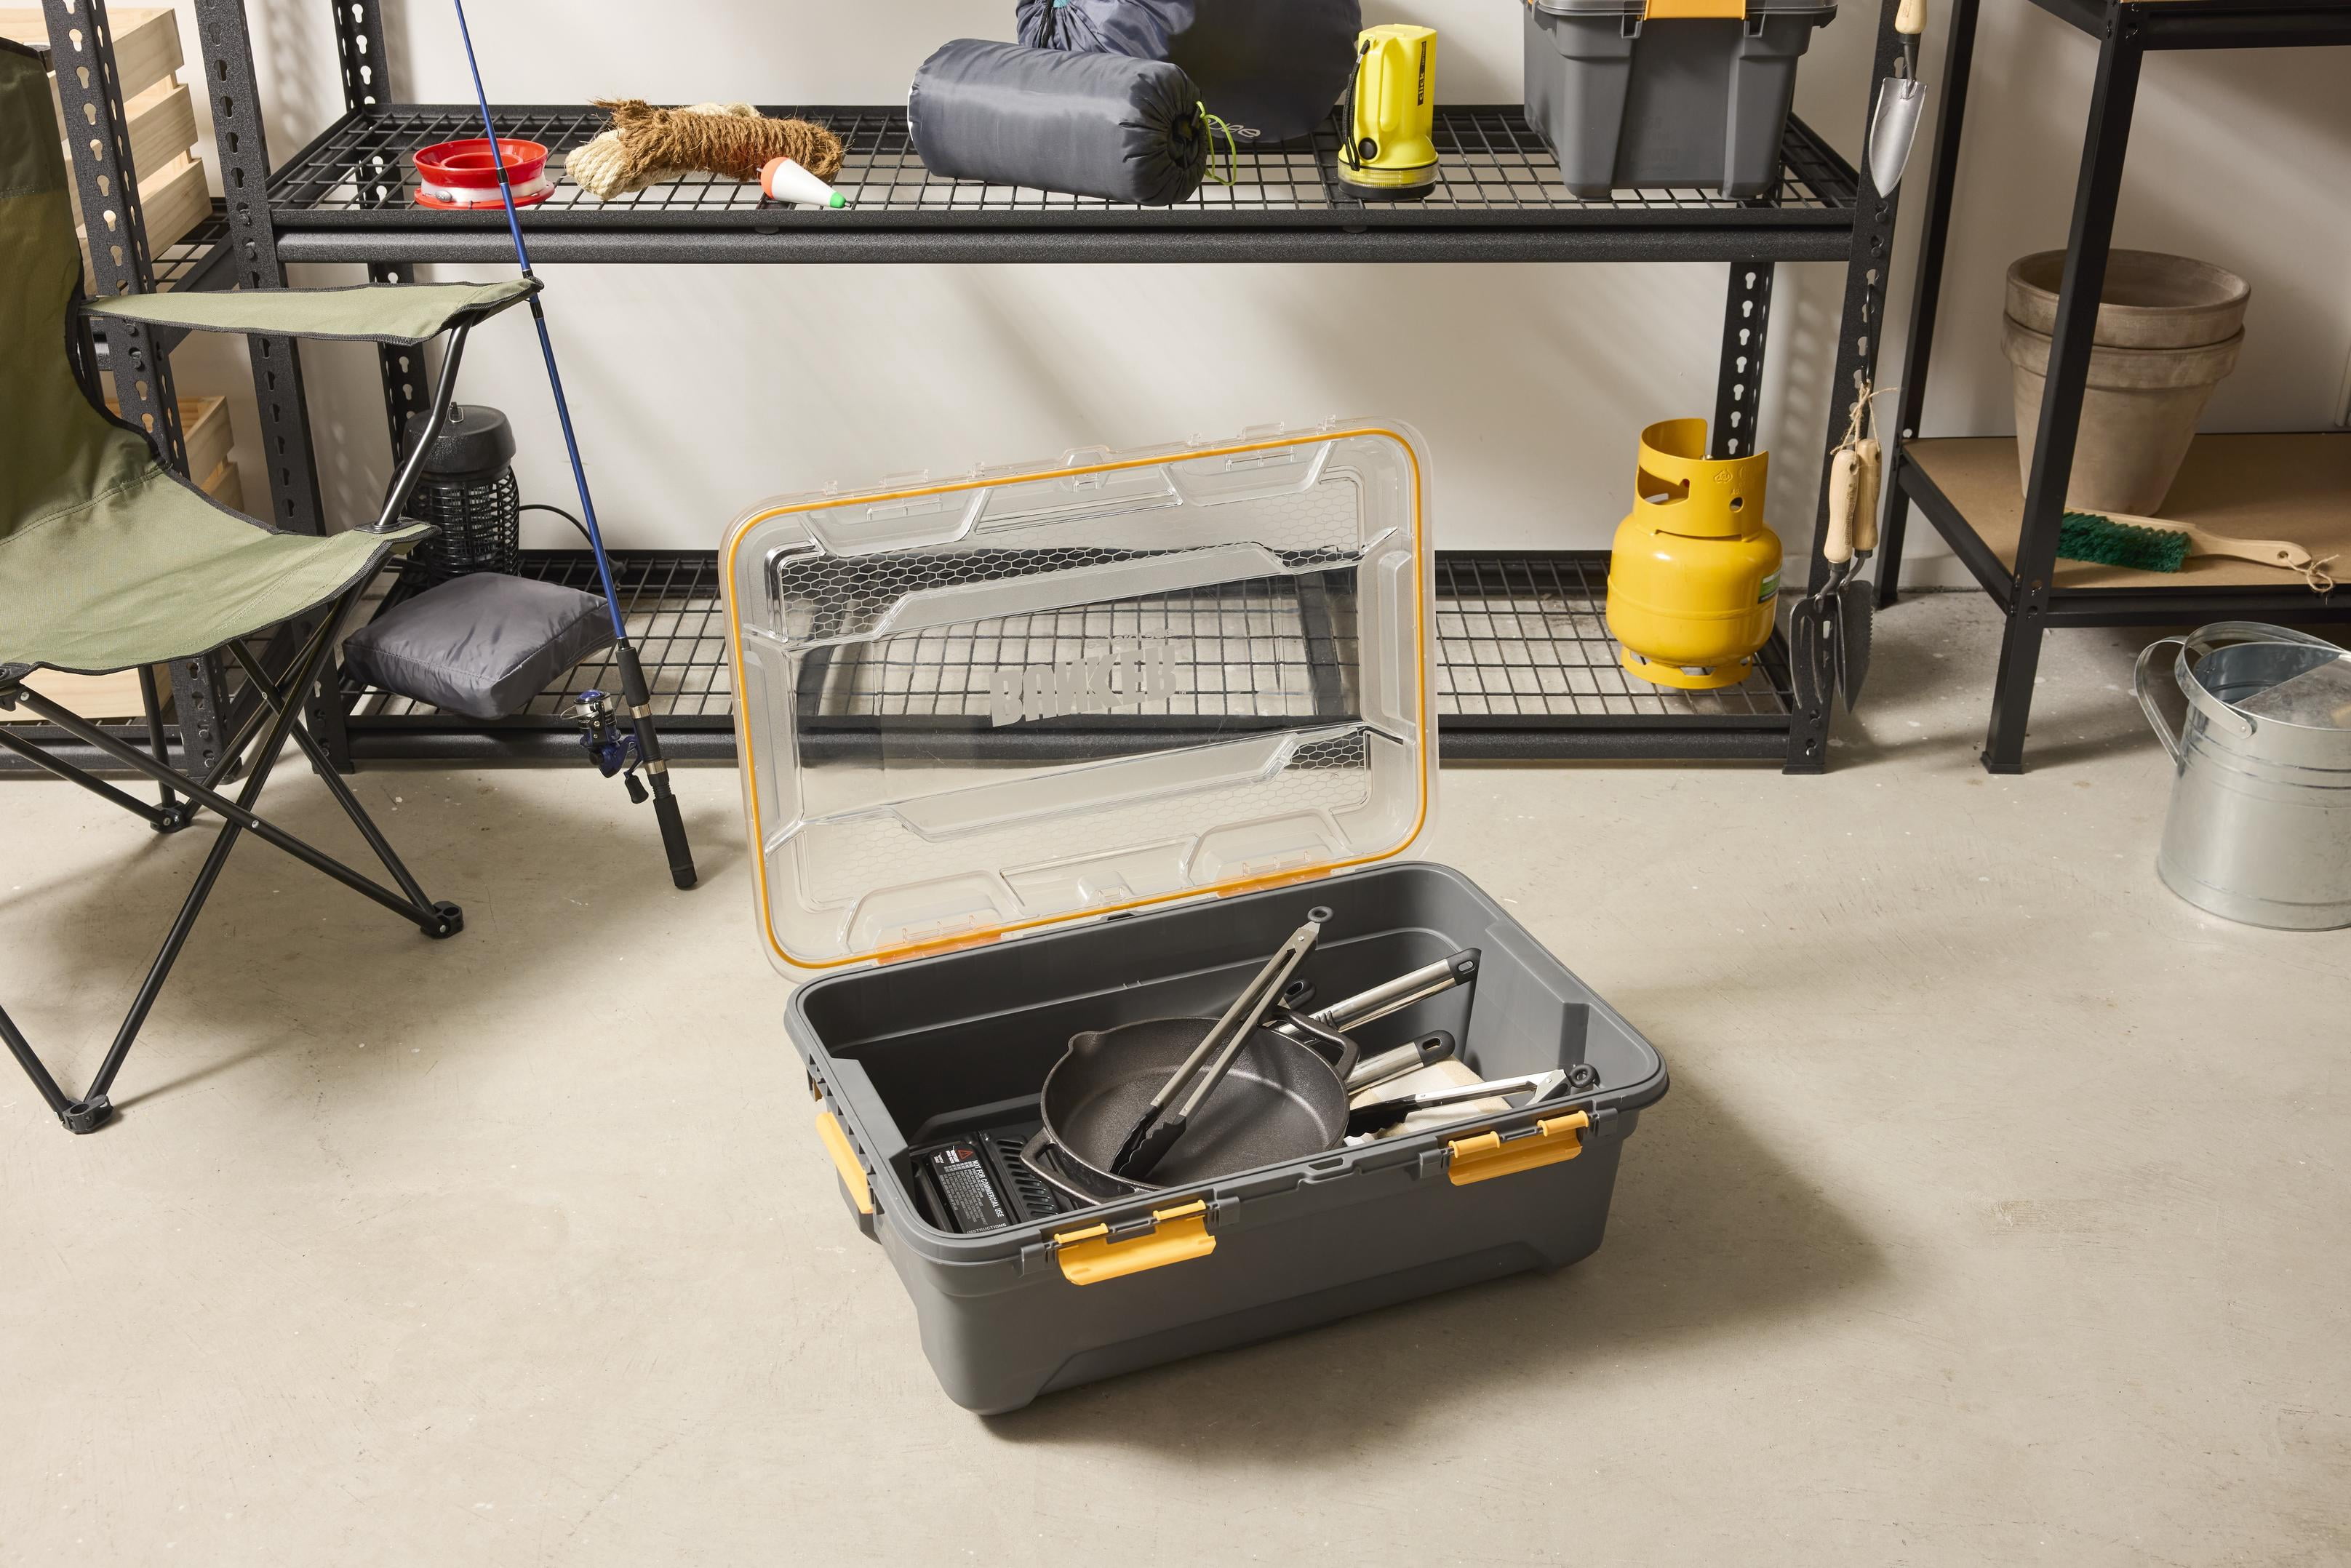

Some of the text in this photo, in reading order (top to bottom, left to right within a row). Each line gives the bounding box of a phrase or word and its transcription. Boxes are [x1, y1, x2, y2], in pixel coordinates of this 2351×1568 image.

[973, 1160, 1005, 1218] NOT FOR COMMERCIAL USE
